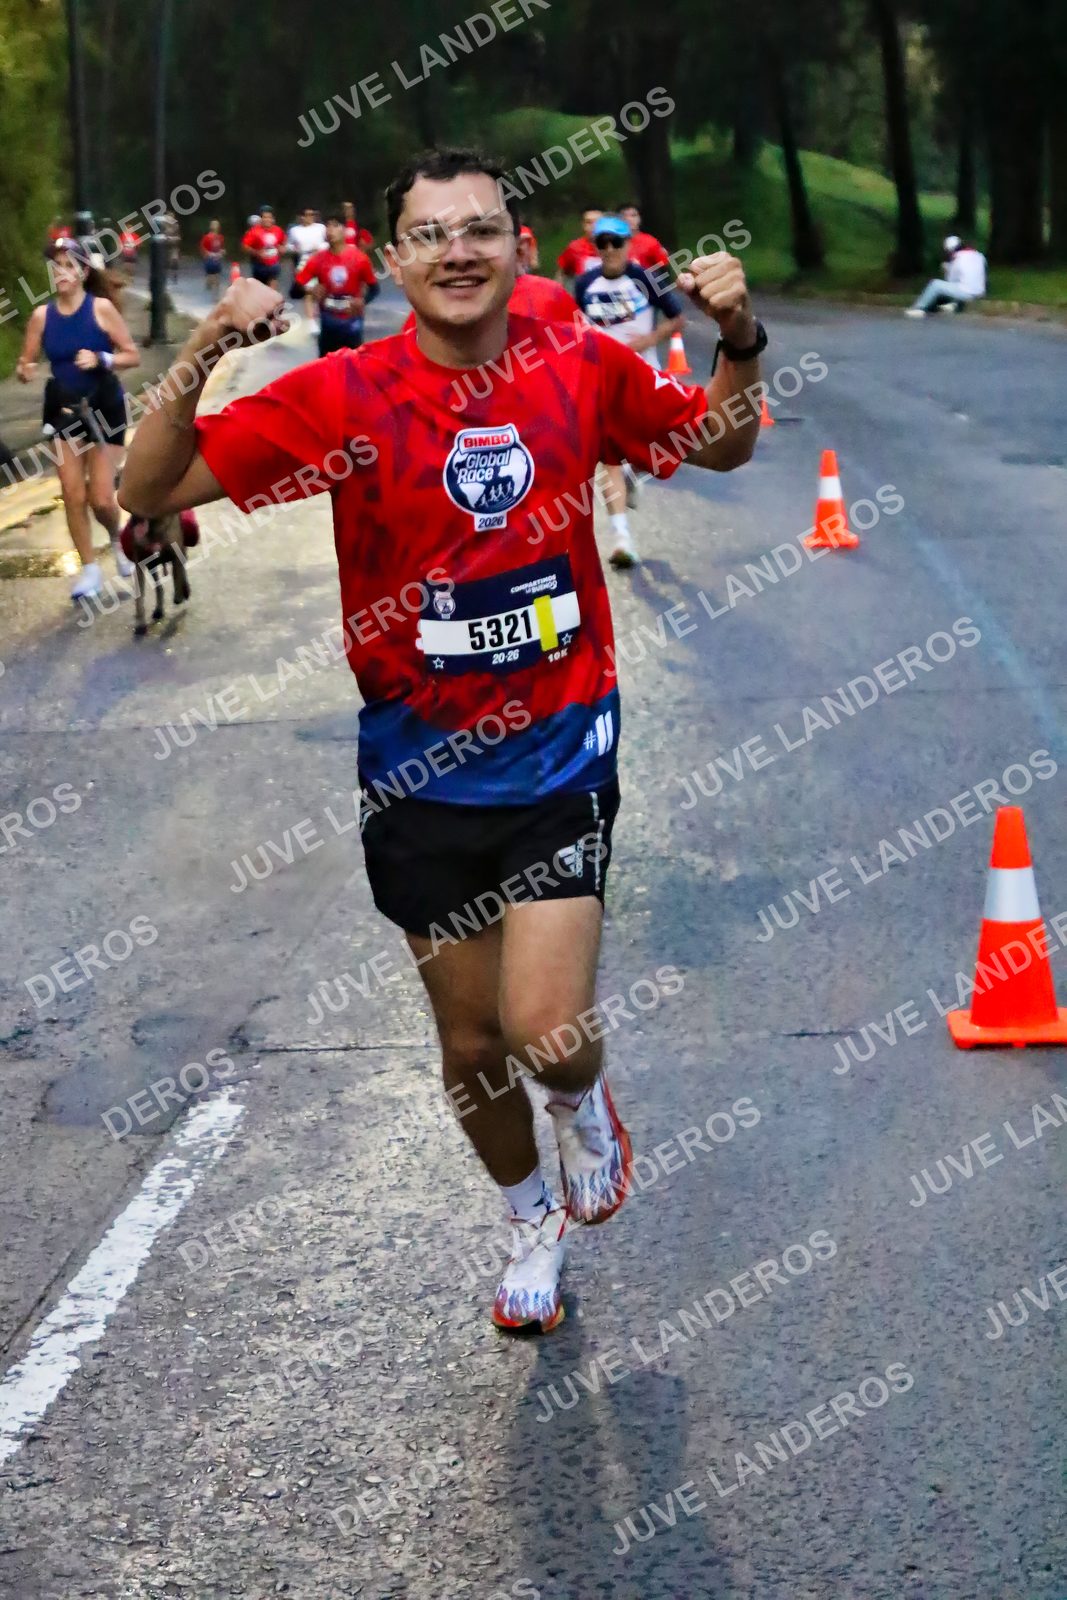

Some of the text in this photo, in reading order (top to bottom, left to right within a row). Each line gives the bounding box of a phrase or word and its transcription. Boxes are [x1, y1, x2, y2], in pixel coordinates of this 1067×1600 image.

[463, 434, 510, 448] BIMBO
[466, 449, 511, 469] Global
[457, 467, 494, 484] Race
[478, 516, 504, 529] 2026
[467, 609, 533, 651] 5321
[547, 648, 568, 663] 10K
